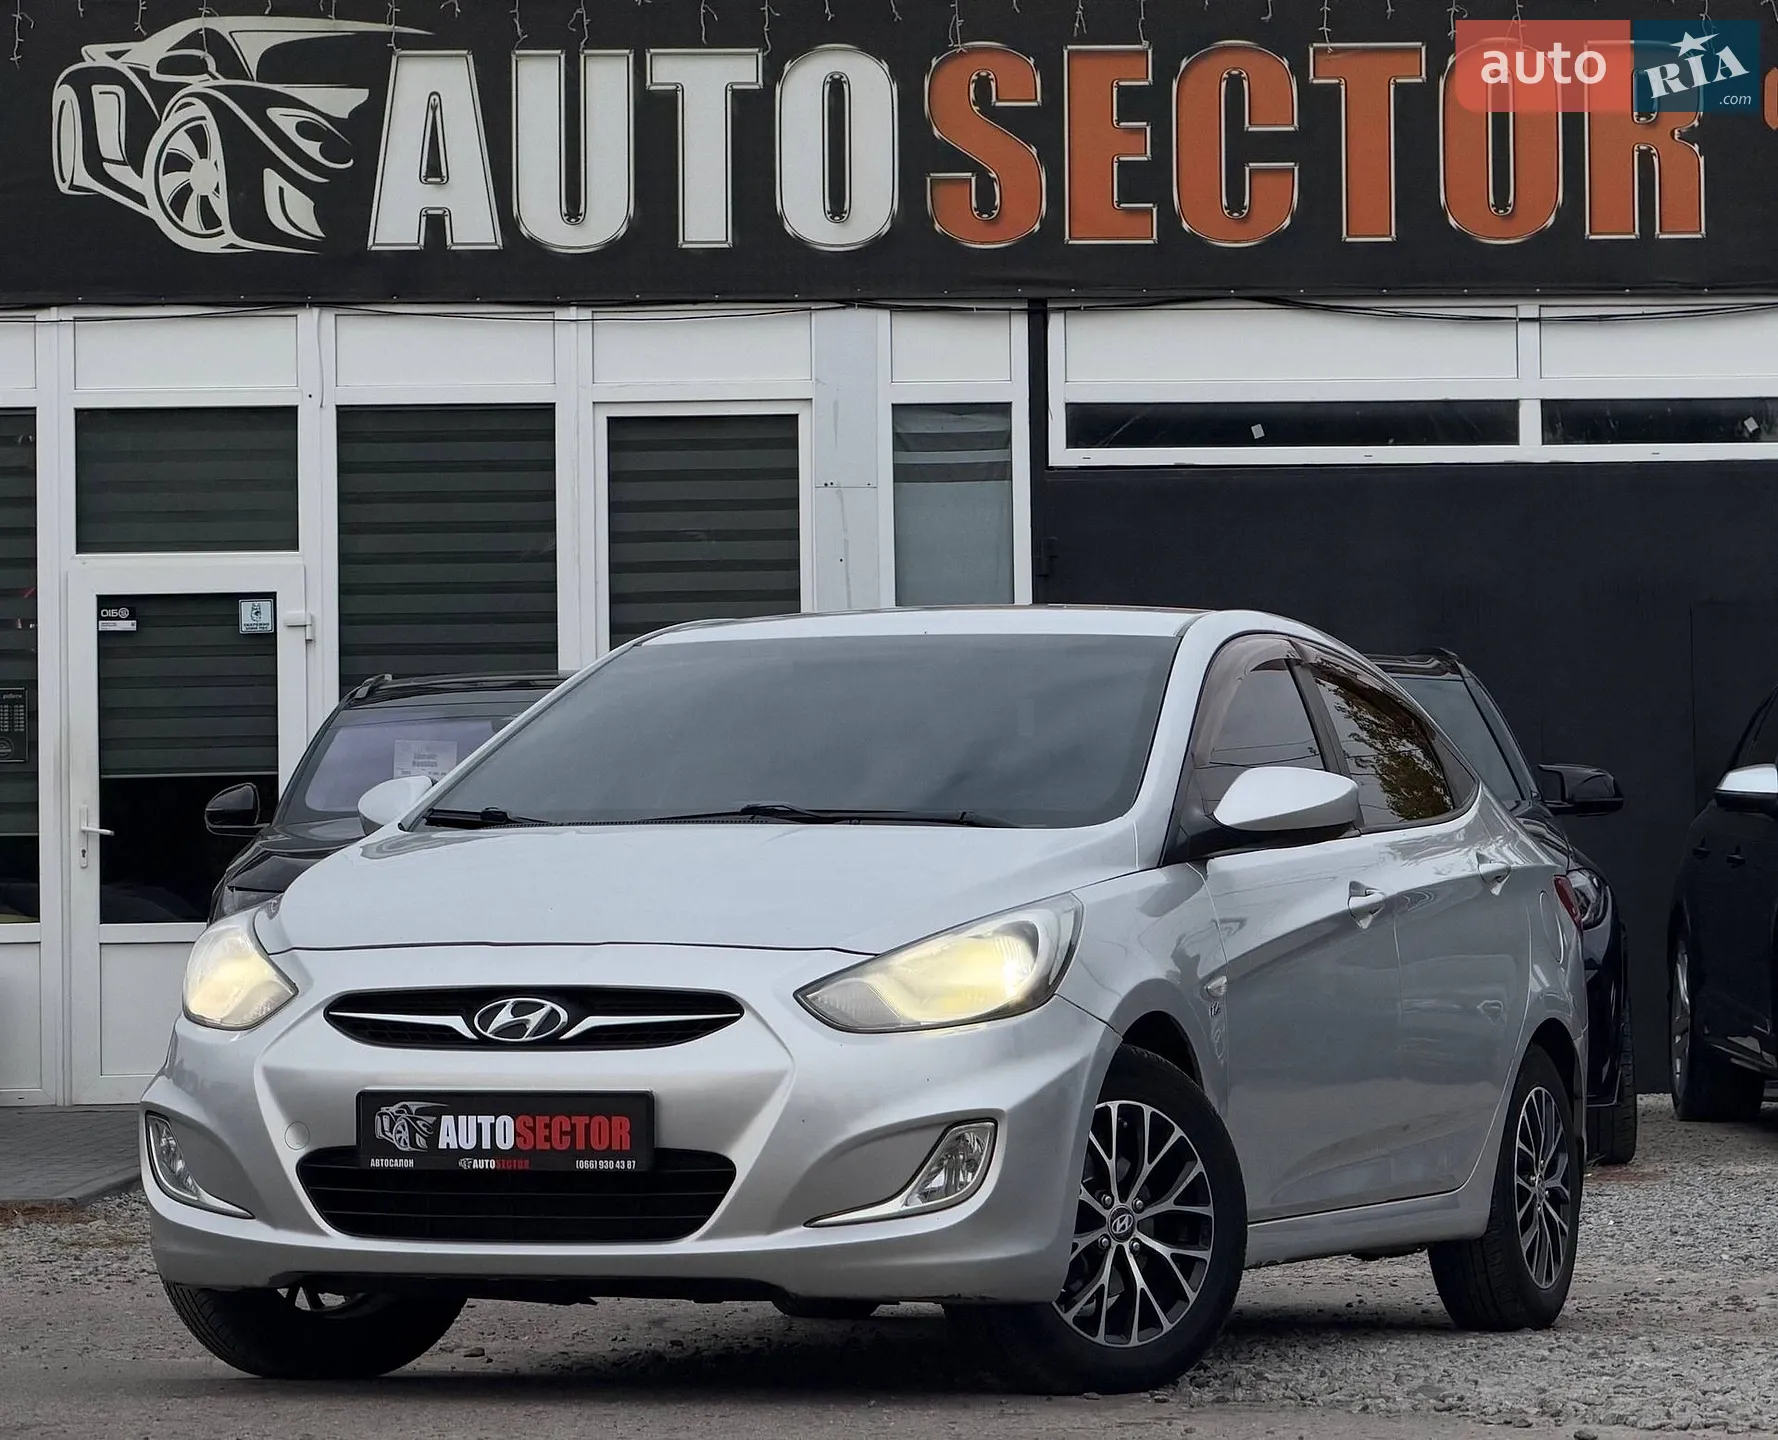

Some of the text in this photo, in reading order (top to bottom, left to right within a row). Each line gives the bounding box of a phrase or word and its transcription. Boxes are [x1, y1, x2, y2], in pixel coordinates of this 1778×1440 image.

[370, 1158, 414, 1168] АВТОСАЛОН
[598, 1160, 614, 1170] 930
[615, 1160, 625, 1170] 43
